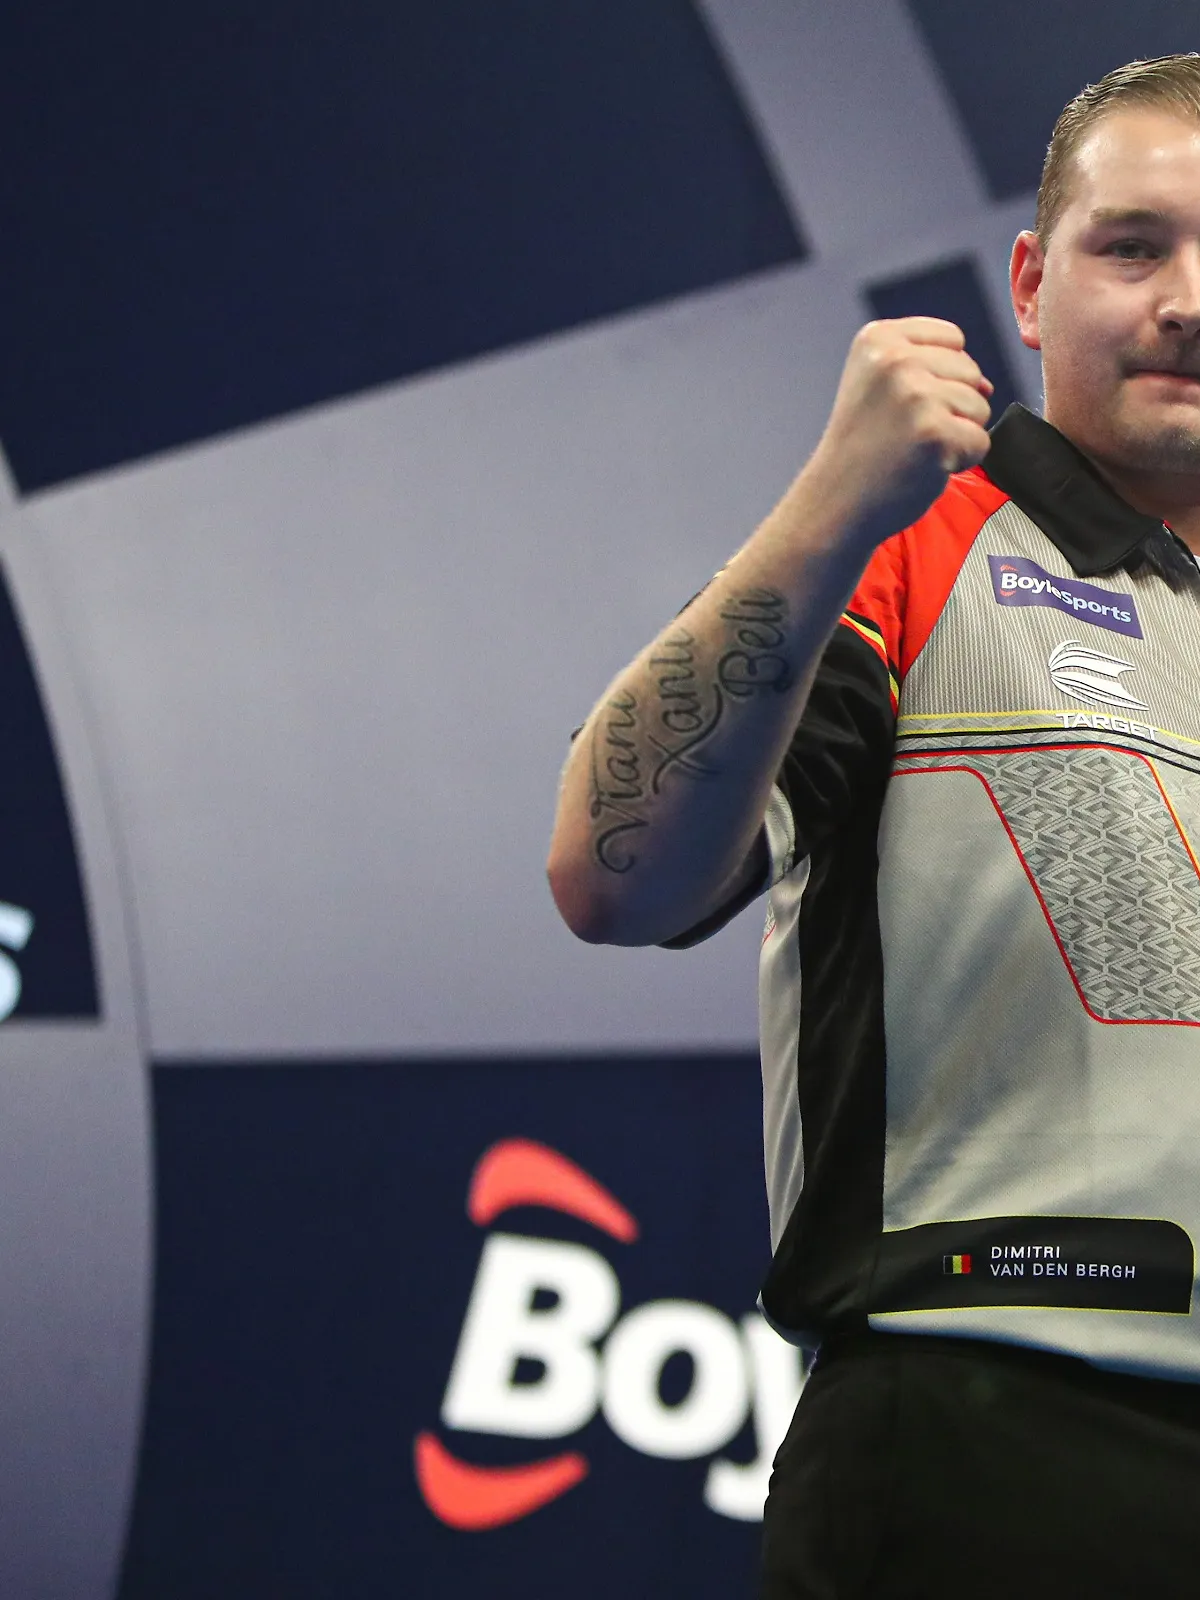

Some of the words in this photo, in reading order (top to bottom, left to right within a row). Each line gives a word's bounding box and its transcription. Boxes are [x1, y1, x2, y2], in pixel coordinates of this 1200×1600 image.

[1056, 712, 1161, 740] TARGET
[991, 1246, 1060, 1259] DIMITRI
[990, 1263, 1024, 1277] VAN
[1032, 1263, 1068, 1276] DEN
[1076, 1264, 1136, 1279] BERGH
